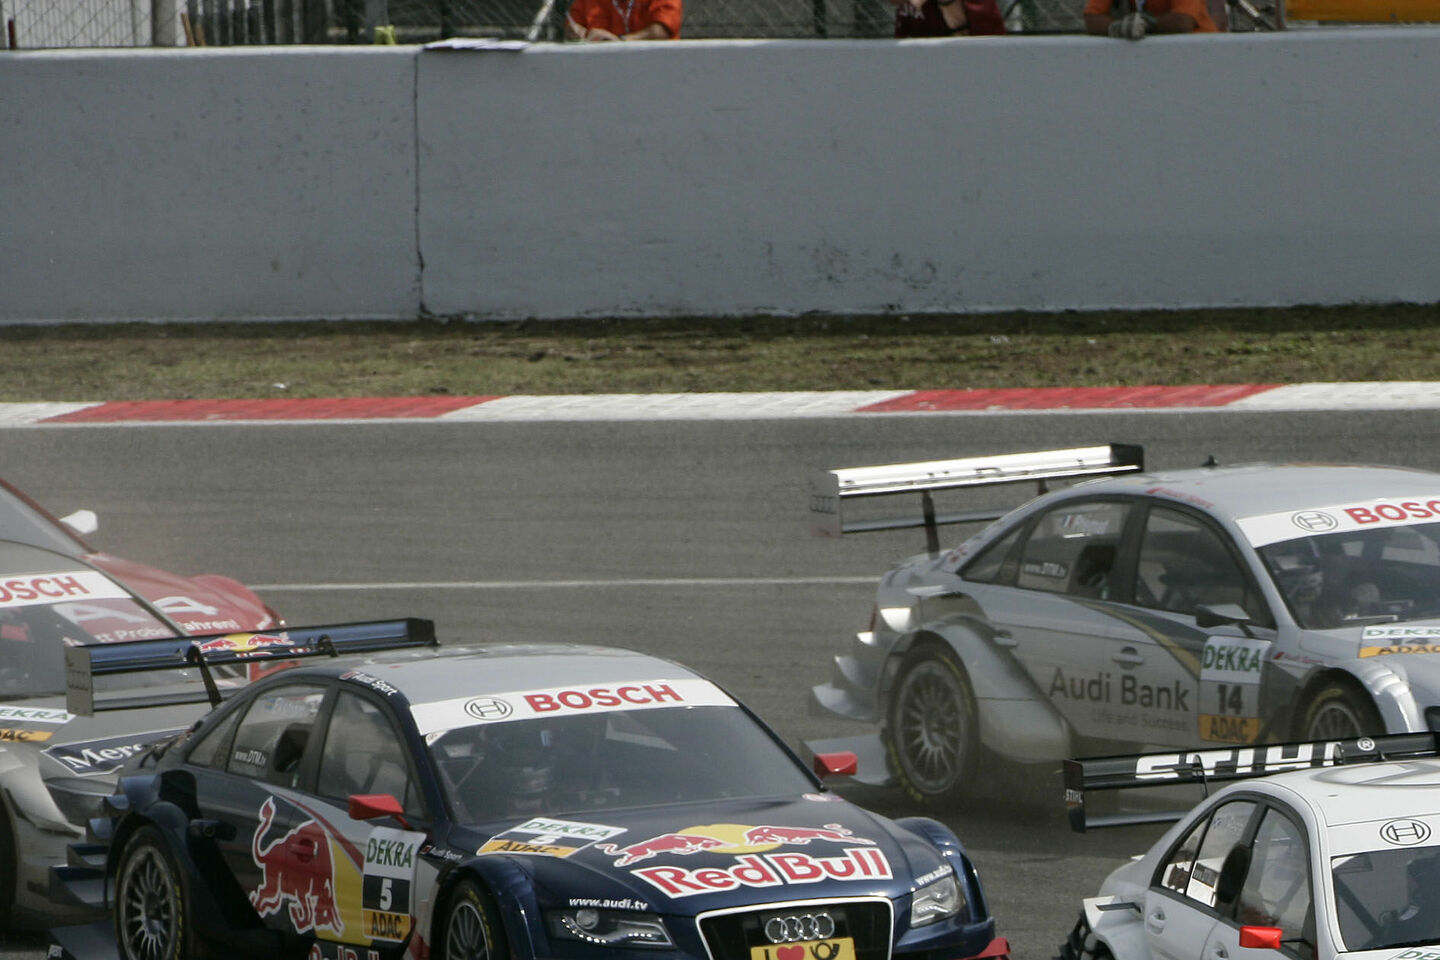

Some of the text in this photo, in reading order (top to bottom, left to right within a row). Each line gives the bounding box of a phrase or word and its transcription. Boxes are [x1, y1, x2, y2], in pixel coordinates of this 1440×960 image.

[0, 576, 91, 603] SCH
[1388, 638, 1433, 647] 14
[1202, 644, 1261, 672] DEKRA
[372, 680, 398, 697] Sport
[523, 684, 684, 714] BOSCH
[1050, 667, 1190, 712] Audi Bank
[1217, 684, 1243, 715] 14
[0, 707, 69, 721] EKRA
[1209, 716, 1250, 740] ADAC
[521, 821, 611, 838] DEKRA
[528, 833, 563, 845] 5
[366, 838, 415, 869] DEKRA
[496, 841, 562, 853] ADAC
[379, 878, 393, 911] 5
[568, 898, 649, 911] www.audi.tv
[370, 912, 403, 938] ADAC
